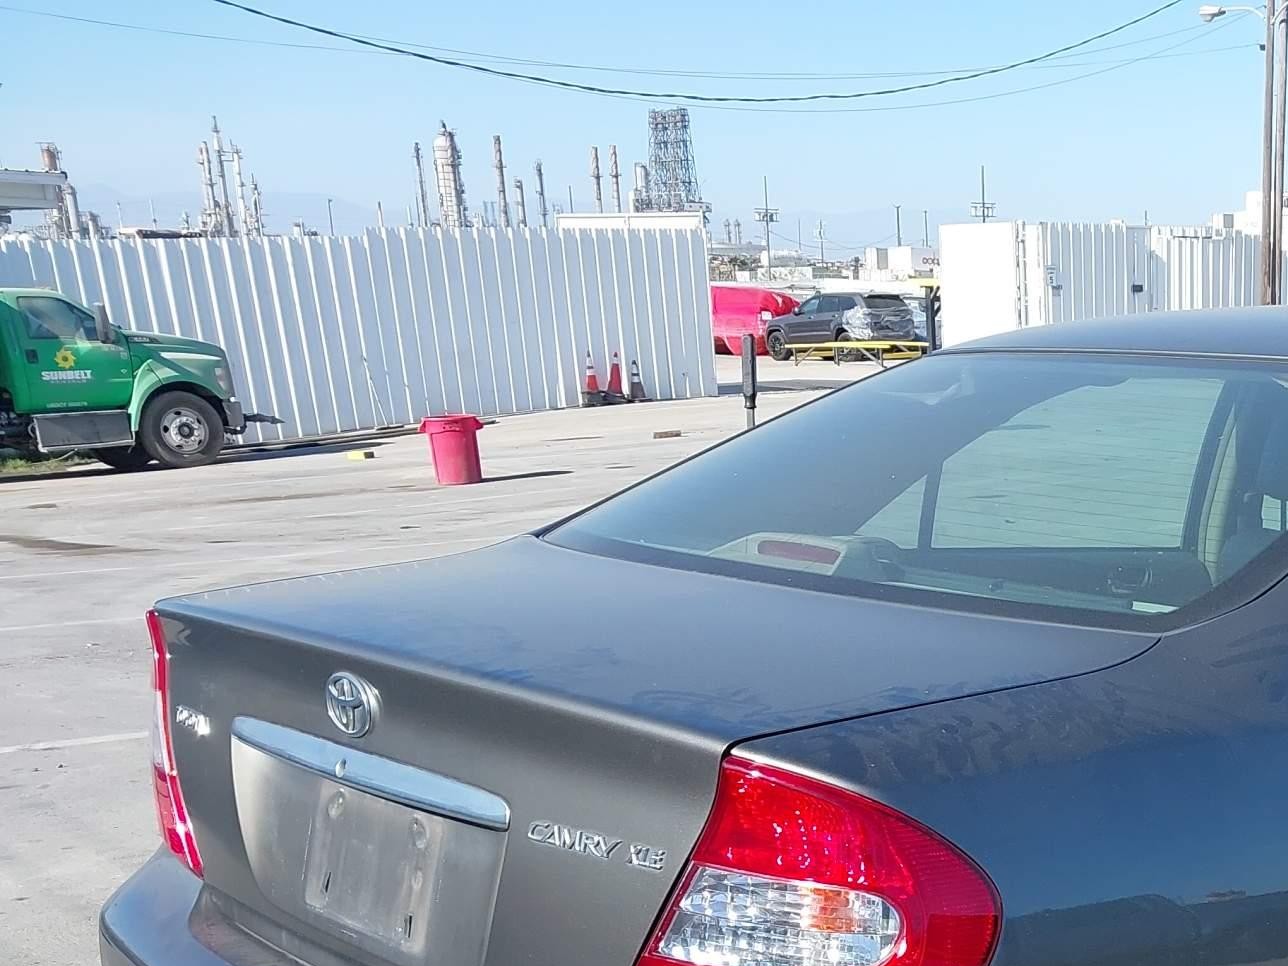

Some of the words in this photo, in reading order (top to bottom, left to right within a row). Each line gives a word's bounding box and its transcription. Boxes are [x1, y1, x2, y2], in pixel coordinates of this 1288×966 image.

[40, 369, 93, 381] SUNBELT
[527, 821, 622, 859] CAMRY
[627, 844, 666, 872] XLE
